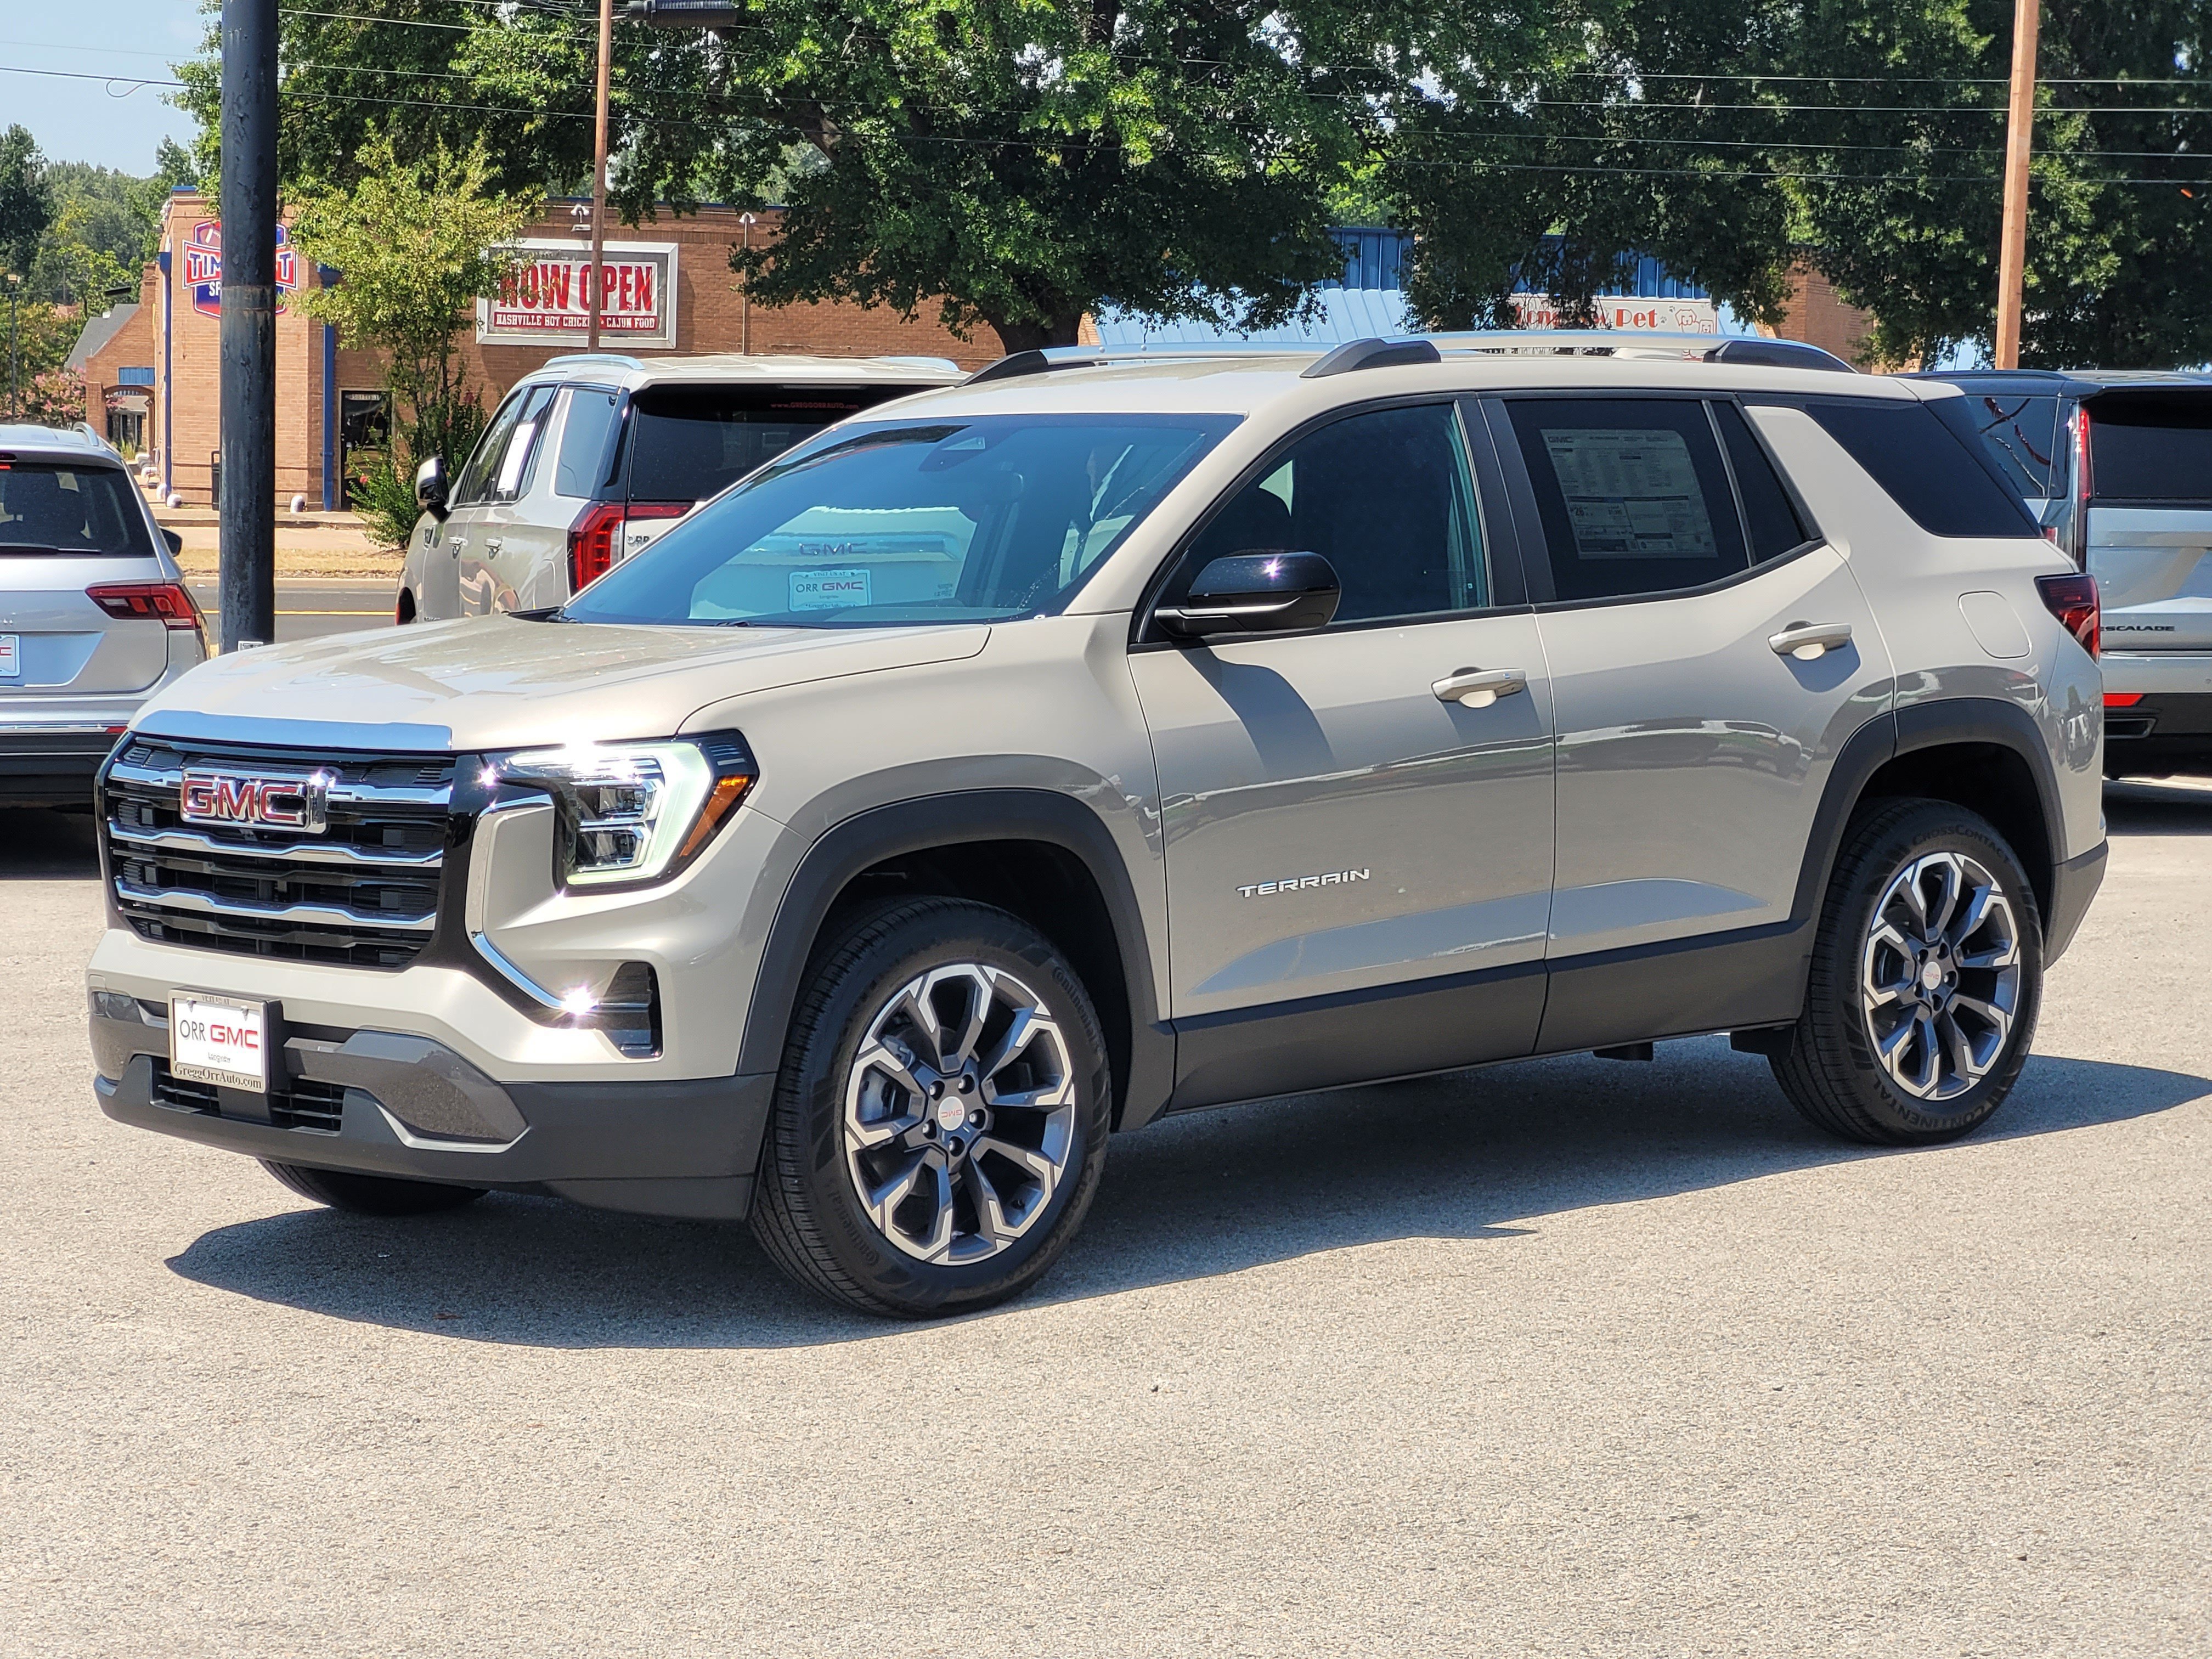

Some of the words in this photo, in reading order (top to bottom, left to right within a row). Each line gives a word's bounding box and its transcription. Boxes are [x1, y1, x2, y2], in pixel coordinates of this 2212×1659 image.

[579, 264, 652, 312] OPEN
[496, 314, 542, 326] NASHVILLE
[544, 315, 560, 327] HOT
[563, 317, 590, 328] CHICK
[606, 317, 632, 328] CAJUN
[634, 318, 655, 329] FOOD
[1616, 308, 1658, 328] Pet
[799, 543, 867, 556] GMC
[795, 583, 819, 593] ORR
[822, 581, 865, 591] GMC
[183, 778, 304, 825] GMC
[1236, 868, 1370, 898] TERRAIN
[180, 1019, 206, 1042] ORR
[210, 1024, 259, 1049] GMC
[208, 1052, 231, 1063] Longview
[174, 1063, 262, 1090] GreggOrrAuto.com
[940, 1109, 963, 1119] GMC
